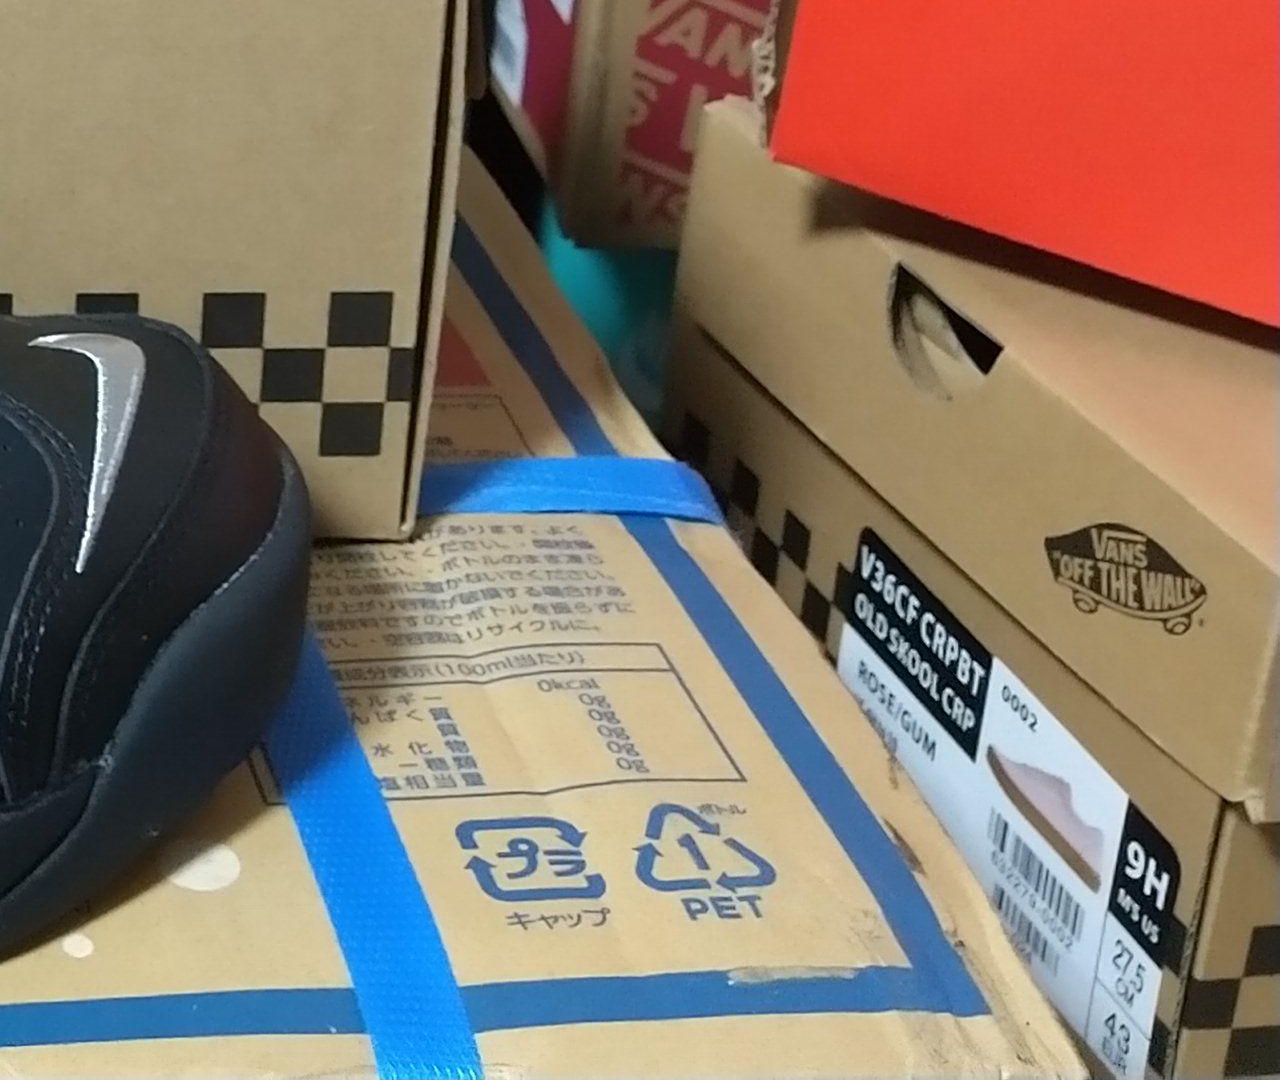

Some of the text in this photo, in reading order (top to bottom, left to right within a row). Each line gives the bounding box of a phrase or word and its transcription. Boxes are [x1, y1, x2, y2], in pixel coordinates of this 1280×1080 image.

[1090, 527, 1148, 569] VANS
[1096, 561, 1140, 609] THE
[860, 545, 986, 697] V36CF CRPBT
[854, 592, 976, 733] OLD SKOOL CRP
[537, 678, 600, 693] 0kcal
[579, 693, 611, 709] 0g
[858, 659, 937, 762] ROSE/GUM
[1001, 685, 1038, 733] 0002
[588, 708, 621, 725] 0g
[597, 724, 630, 740] 0g
[606, 741, 640, 757] 0g
[616, 757, 650, 773] 0g
[1125, 840, 1170, 912] 9H
[505, 907, 611, 931] キャップ
[681, 894, 764, 921] PET
[1141, 914, 1161, 944] US
[1103, 1013, 1131, 1055] 43
